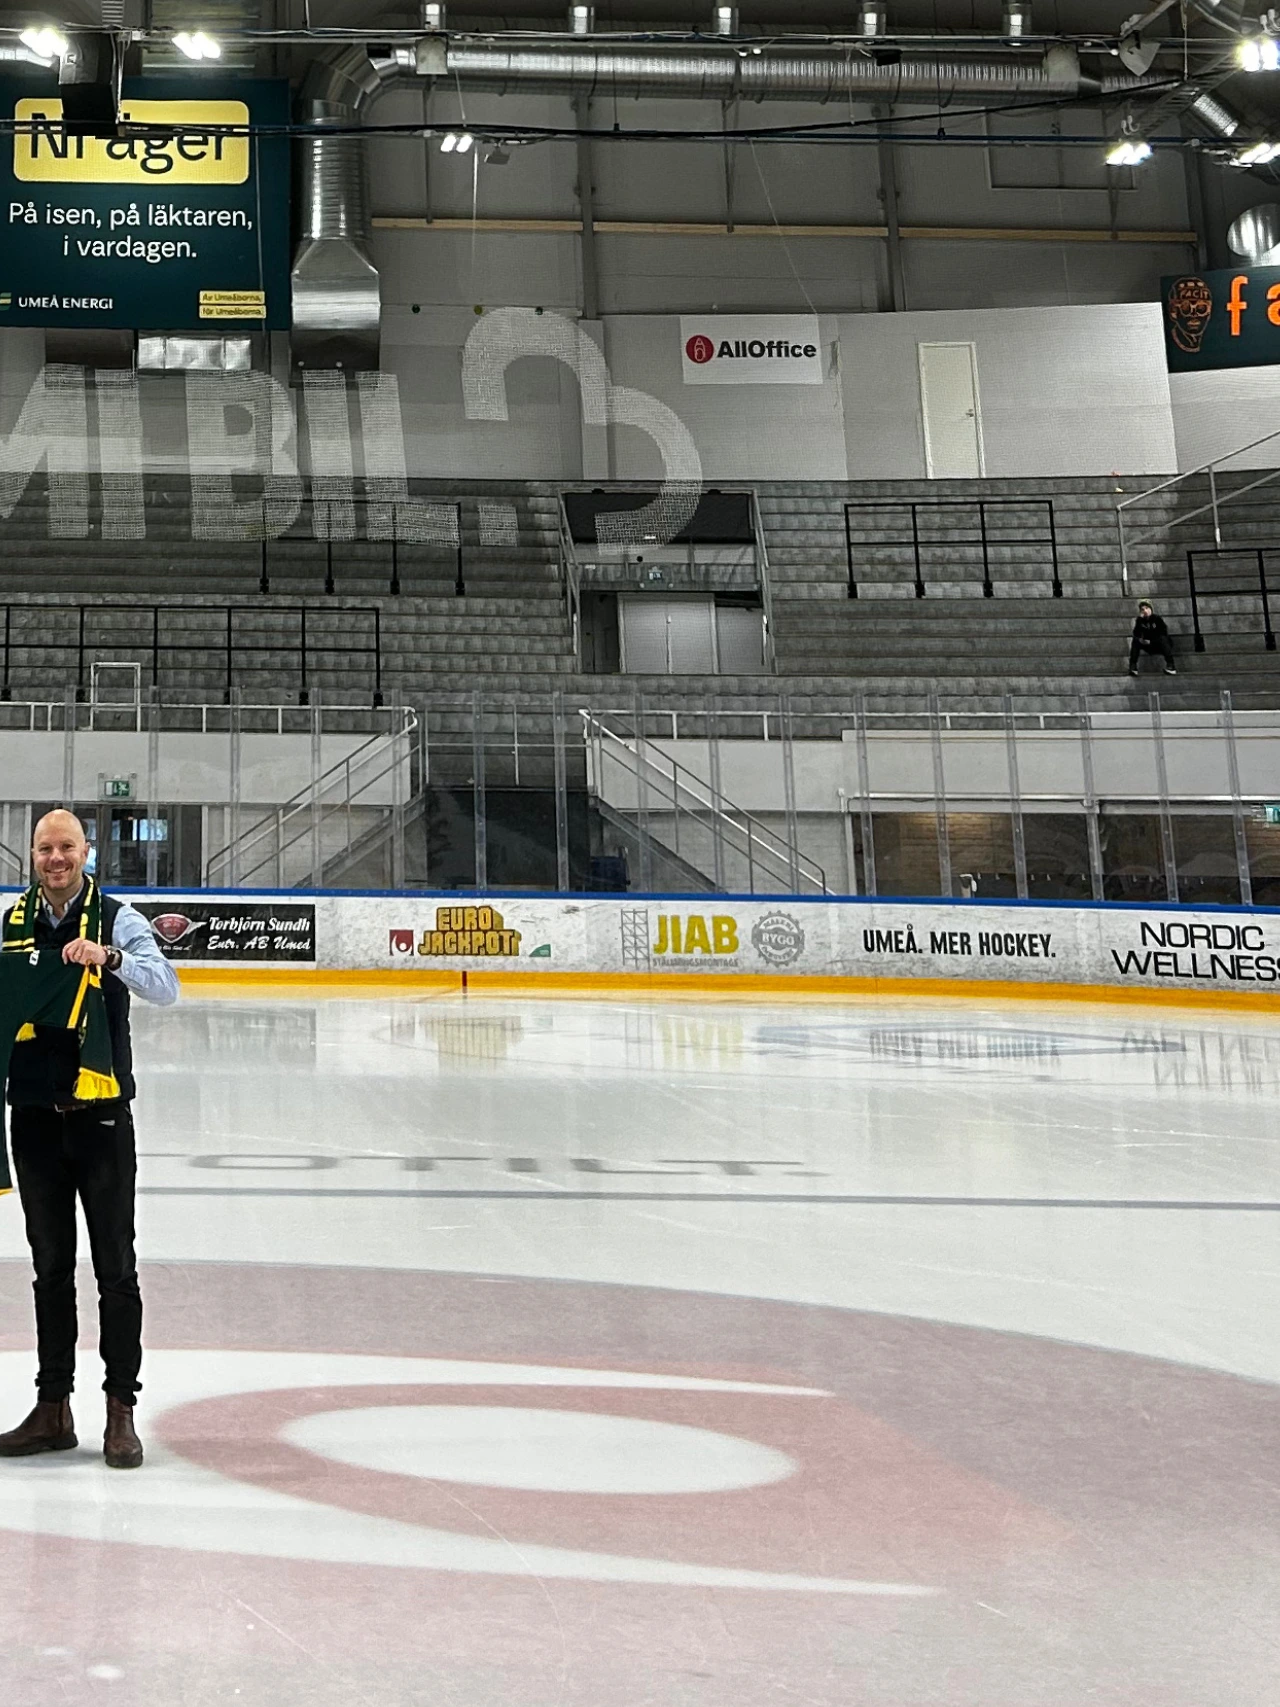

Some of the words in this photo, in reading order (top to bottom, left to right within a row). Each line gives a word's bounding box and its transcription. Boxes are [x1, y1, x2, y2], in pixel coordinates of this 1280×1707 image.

[9, 202, 38, 224] På
[46, 203, 102, 228] isen,
[110, 203, 141, 230] på
[148, 204, 254, 230] läktaren,
[63, 235, 69, 256] i
[77, 236, 197, 263] vardagen.
[19, 293, 60, 309] UMEÅ
[62, 296, 114, 310] ENERGI
[717, 340, 817, 358] AllOffice
[209, 916, 265, 933] Torbjörn
[267, 917, 311, 932] Sundh
[437, 906, 496, 930] EURO
[207, 935, 239, 950] Entr.
[243, 936, 270, 950] AB
[418, 930, 517, 956] JACKPOT
[653, 914, 740, 954] JIAB
[863, 923, 923, 954] UMEÅ.
[930, 931, 972, 956] MER
[978, 932, 1056, 958] HOCKEY.
[1140, 921, 1265, 951] NORDIC
[1111, 949, 1280, 982] WELLNES
